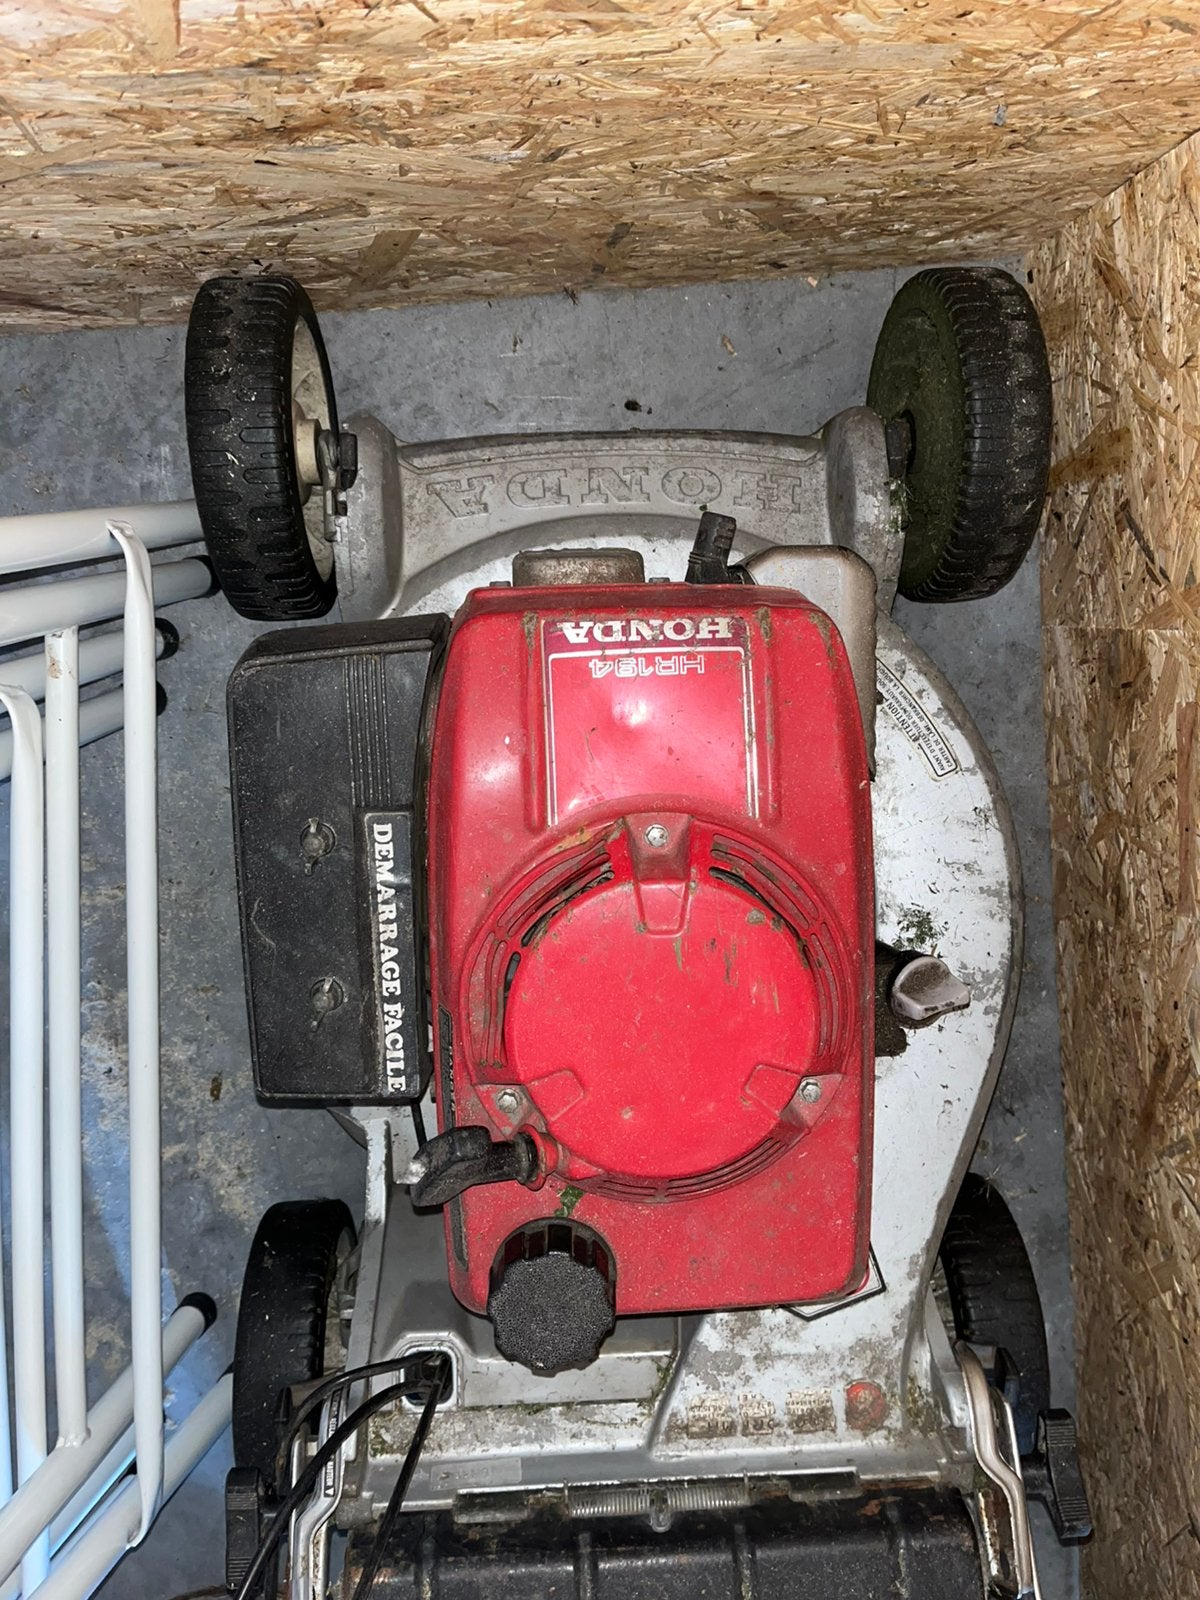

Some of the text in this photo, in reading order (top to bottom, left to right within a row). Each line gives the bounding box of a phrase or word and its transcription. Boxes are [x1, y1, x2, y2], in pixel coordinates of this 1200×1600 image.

[427, 466, 802, 519] HONDA
[557, 617, 733, 644] HONDA
[588, 655, 706, 679] HR194
[891, 682, 900, 691] LA
[886, 702, 920, 743] ATTENTION
[932, 737, 941, 746] DE
[932, 754, 945, 771] AVANT
[938, 745, 953, 768] CARTER
[373, 823, 407, 1093] DEMARRAGE FACILE
